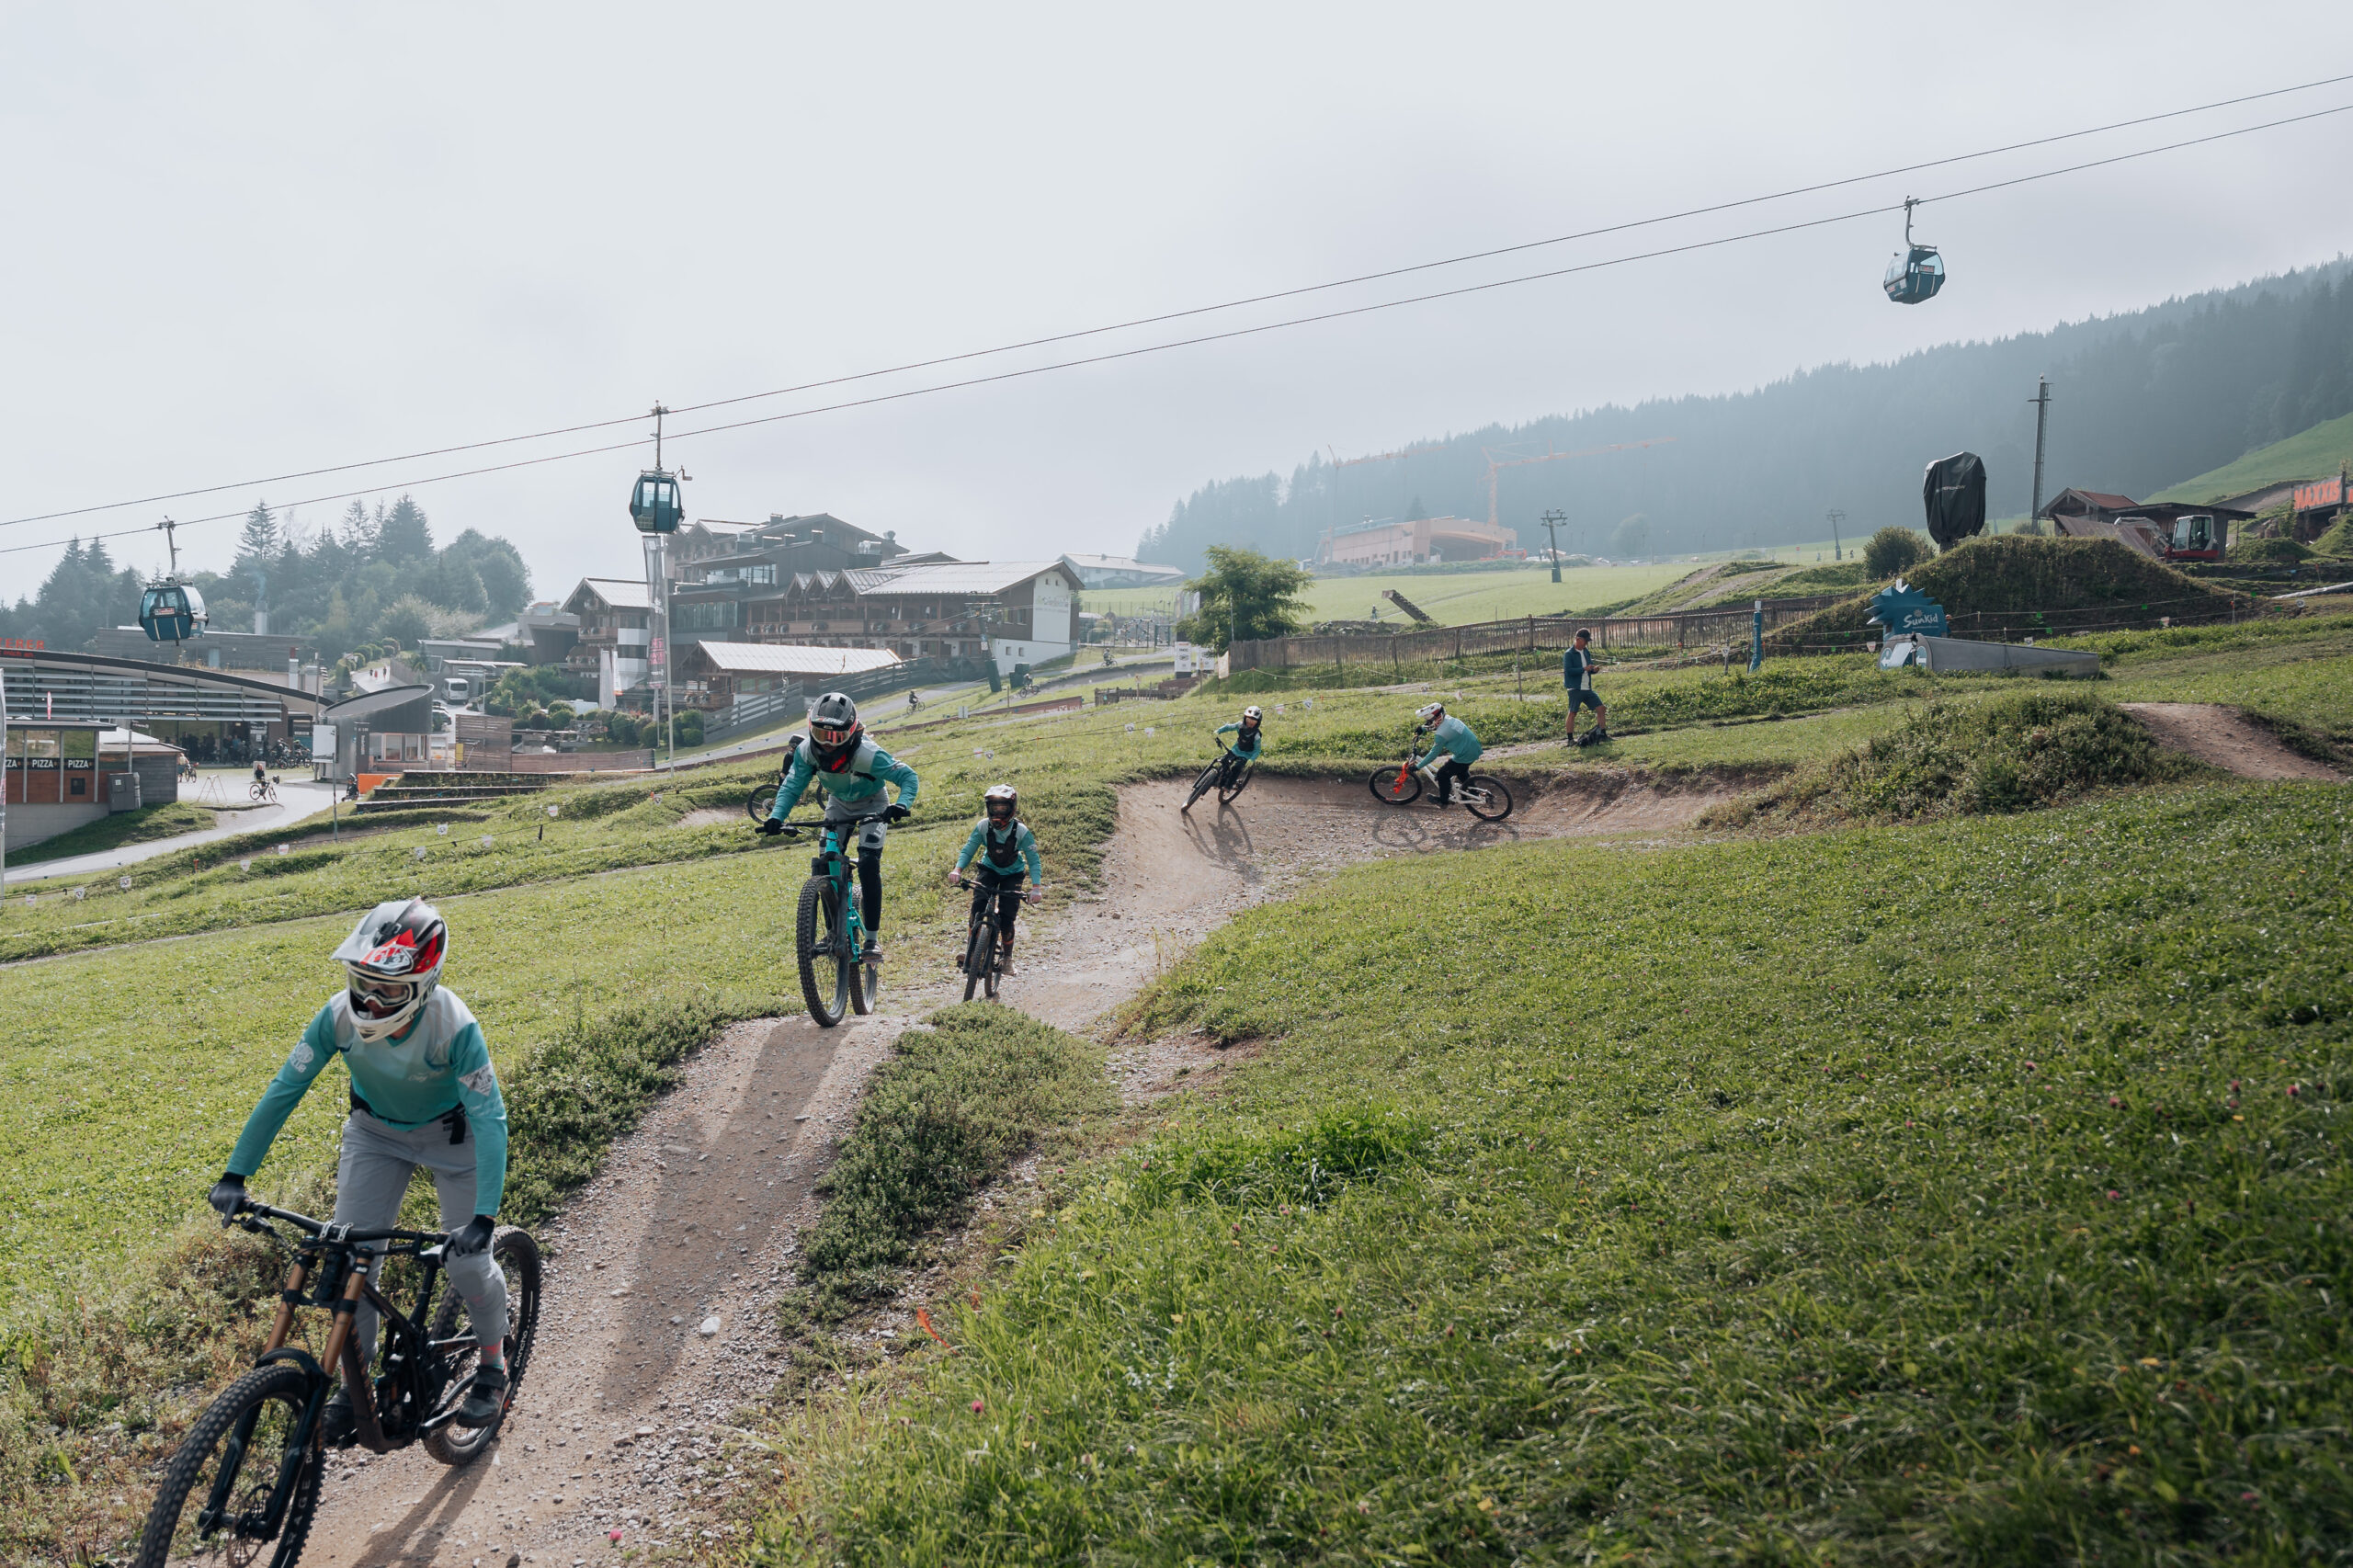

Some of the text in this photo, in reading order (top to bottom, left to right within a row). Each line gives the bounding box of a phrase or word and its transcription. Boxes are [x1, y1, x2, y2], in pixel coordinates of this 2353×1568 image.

[2293, 480, 2341, 509] MAXXIS
[32, 759, 53, 767] PIZZA
[68, 760, 89, 768] PIZZA
